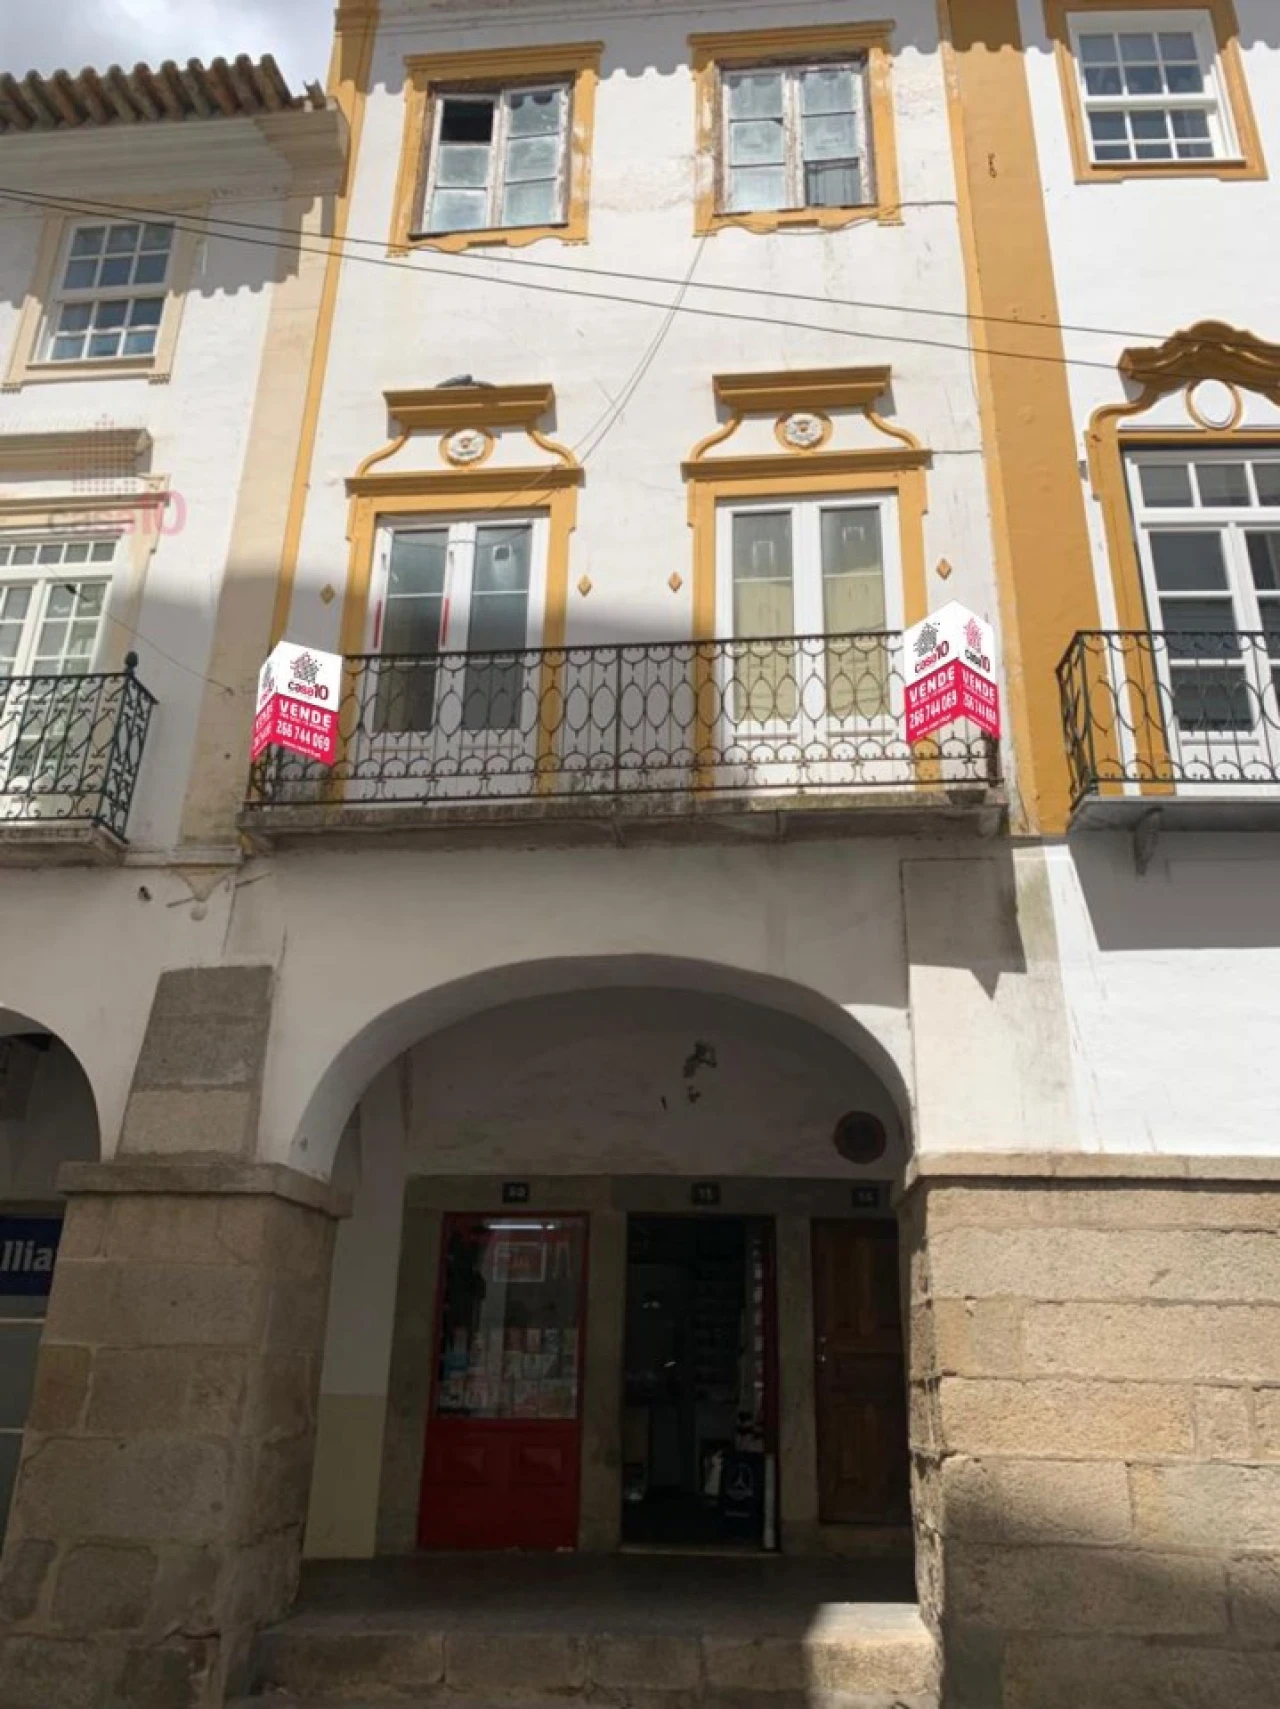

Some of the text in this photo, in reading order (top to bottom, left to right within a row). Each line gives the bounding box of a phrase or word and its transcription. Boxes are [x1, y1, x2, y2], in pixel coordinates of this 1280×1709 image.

[909, 665, 955, 703] VENDE
[963, 669, 996, 700] VENDE
[278, 699, 332, 727] VENDE
